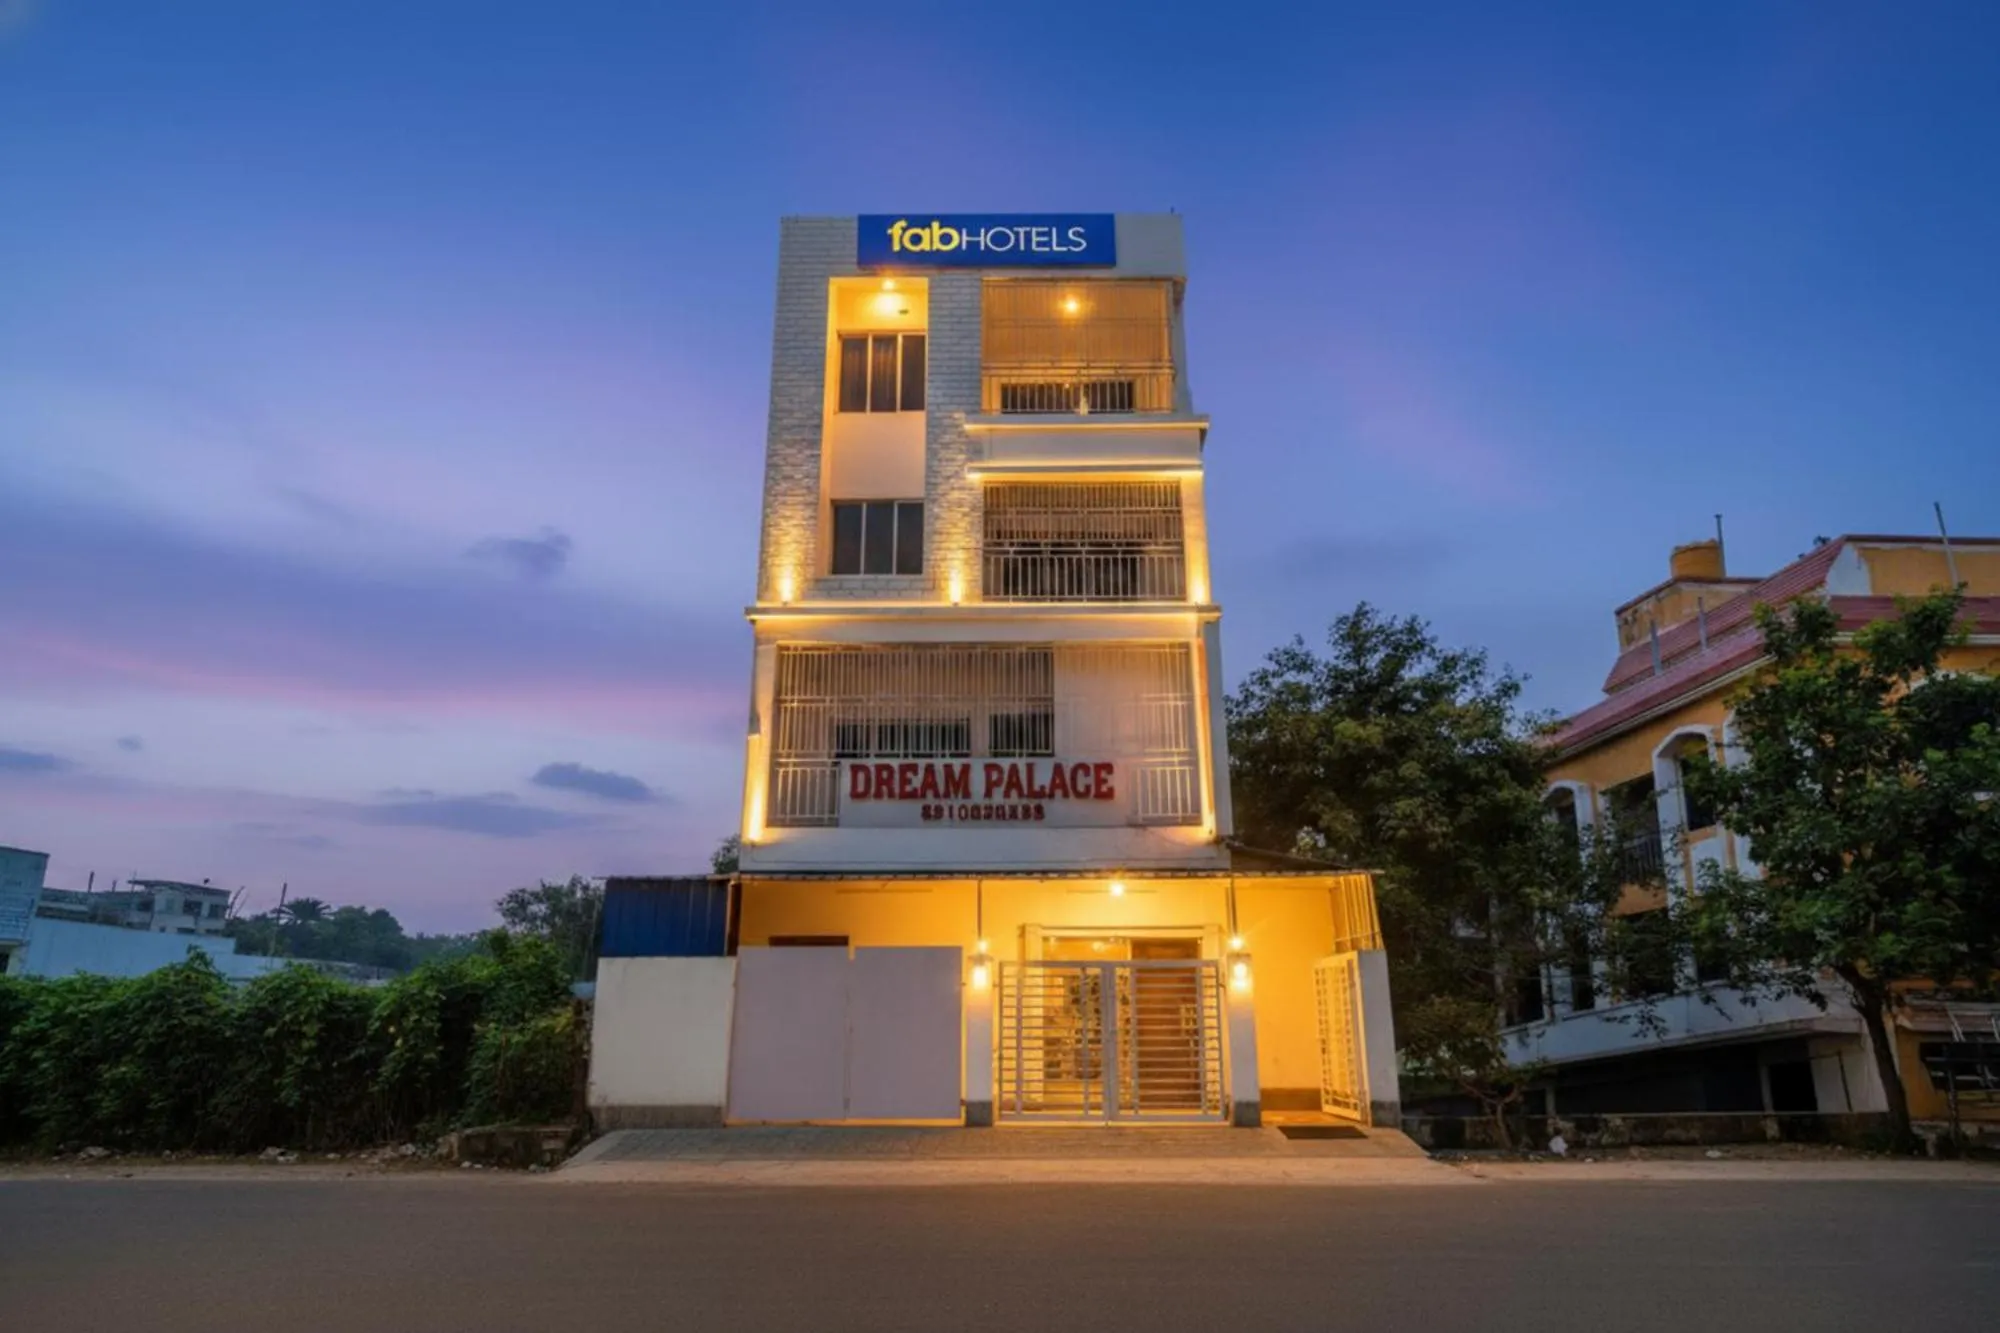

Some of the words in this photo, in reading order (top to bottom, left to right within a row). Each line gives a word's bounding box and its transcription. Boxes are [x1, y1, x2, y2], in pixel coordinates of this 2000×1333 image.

[887, 219, 1088, 252] fabHOTELS
[849, 763, 971, 800] DREAM
[984, 762, 1115, 800] PALACE
